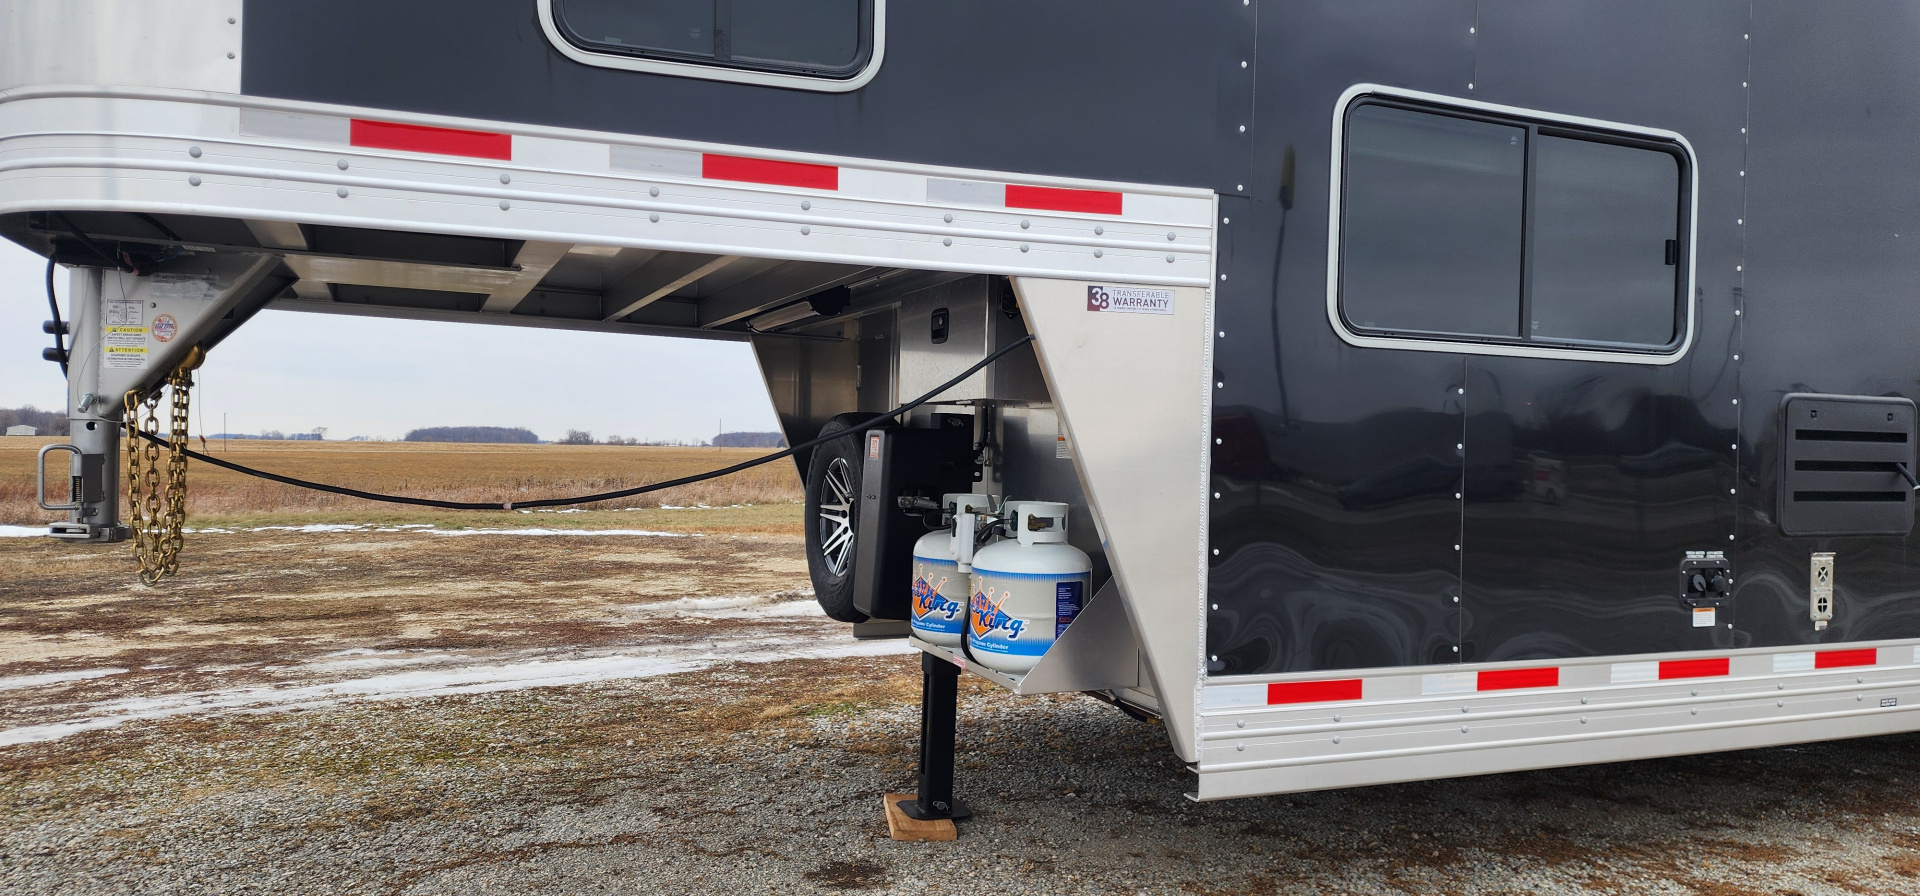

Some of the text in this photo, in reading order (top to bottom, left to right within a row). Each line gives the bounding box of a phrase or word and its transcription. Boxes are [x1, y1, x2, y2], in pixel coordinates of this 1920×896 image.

[1112, 289, 1169, 299] TRANSFERABLE
[1112, 297, 1169, 308] WARRANTY
[978, 609, 1024, 638] King
